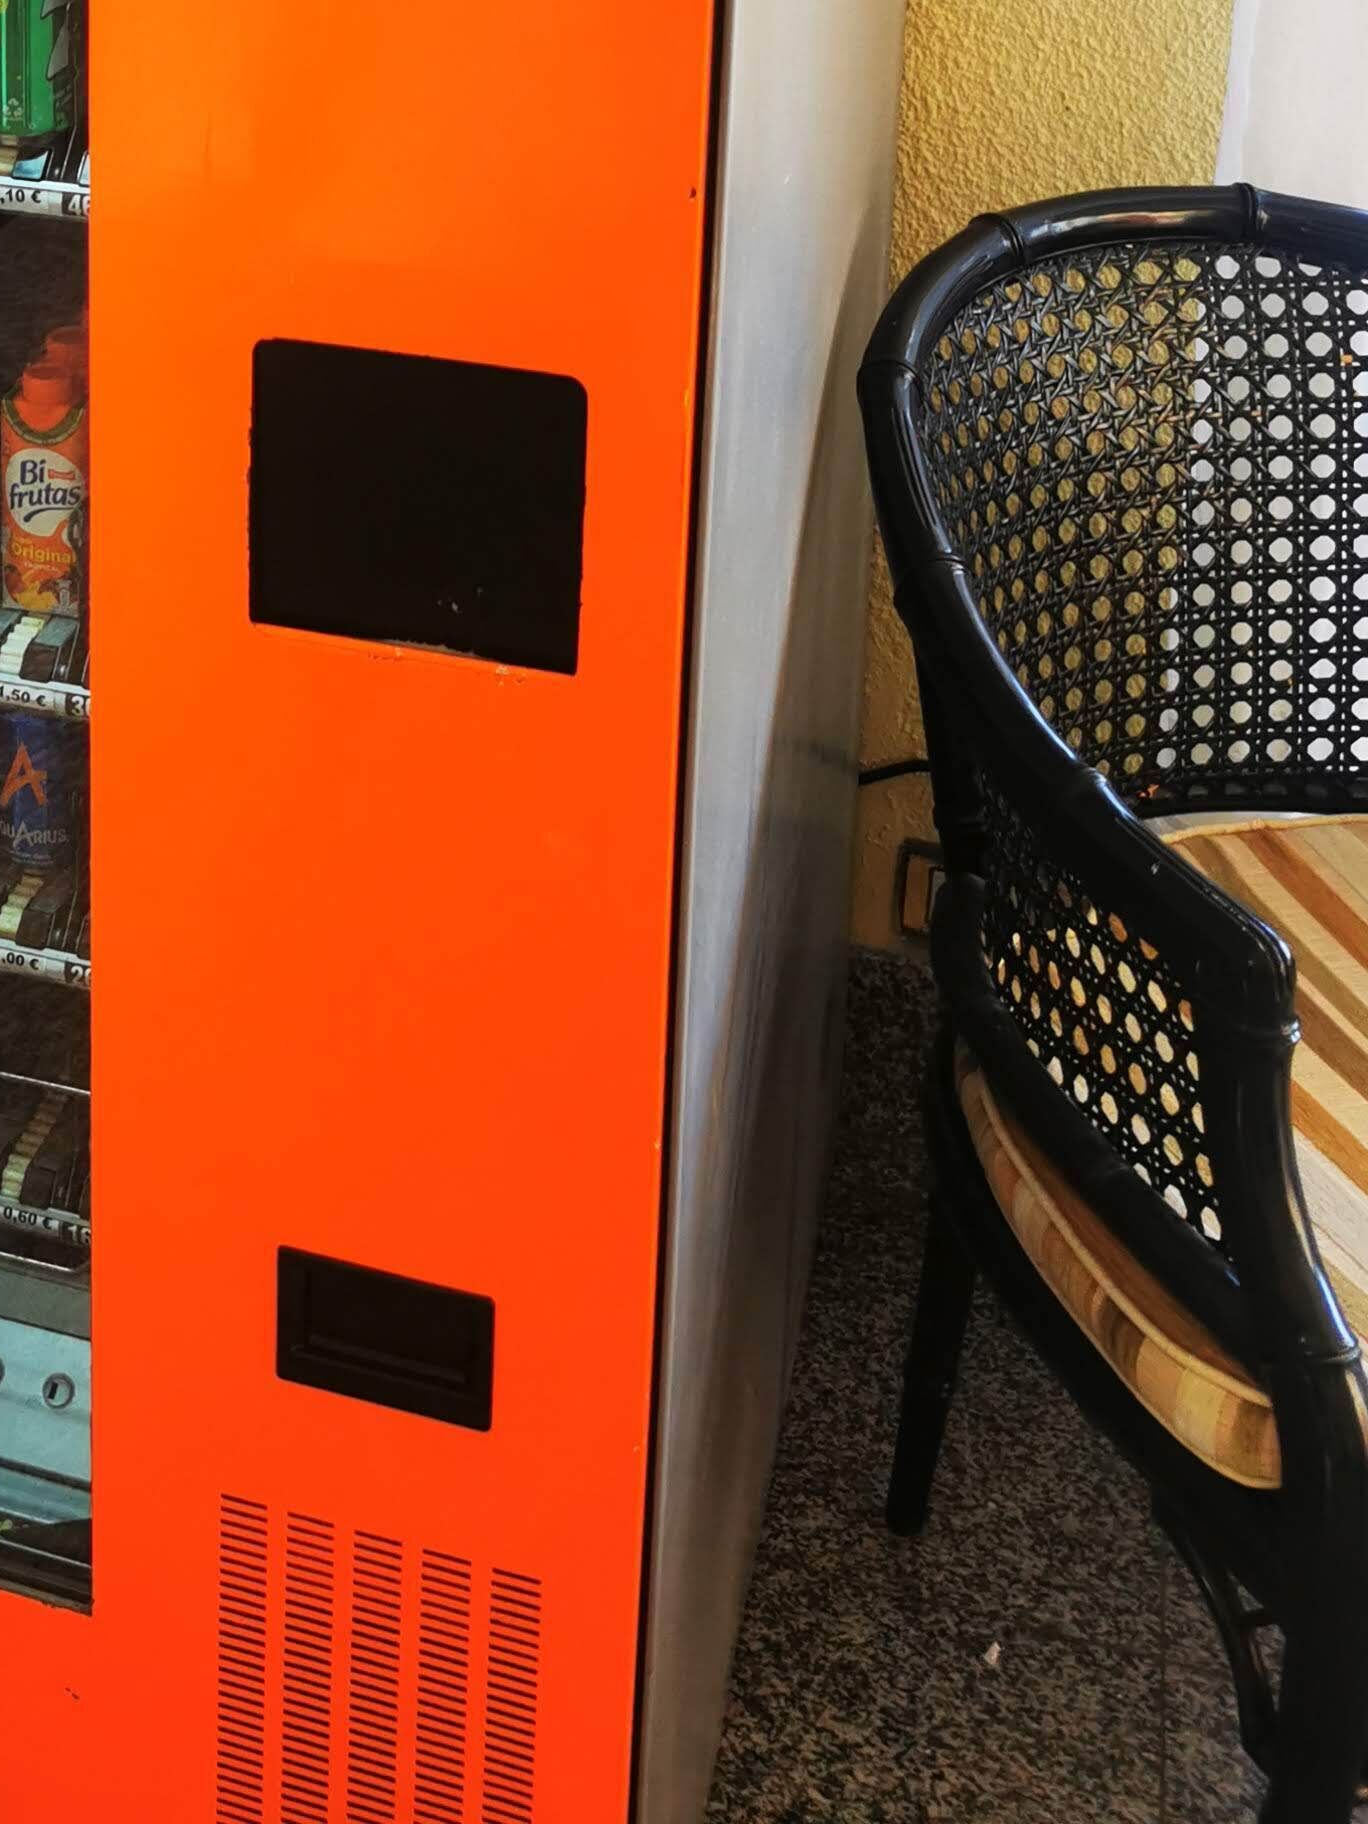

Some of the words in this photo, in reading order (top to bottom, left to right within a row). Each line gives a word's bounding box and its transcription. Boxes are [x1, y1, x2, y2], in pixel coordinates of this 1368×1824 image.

[30, 189, 43, 205] €
[20, 459, 46, 486] Bi
[9, 482, 82, 510] frutas
[34, 692, 47, 707] €
[28, 954, 40, 970] €
[3, 1206, 38, 1227] 0,60
